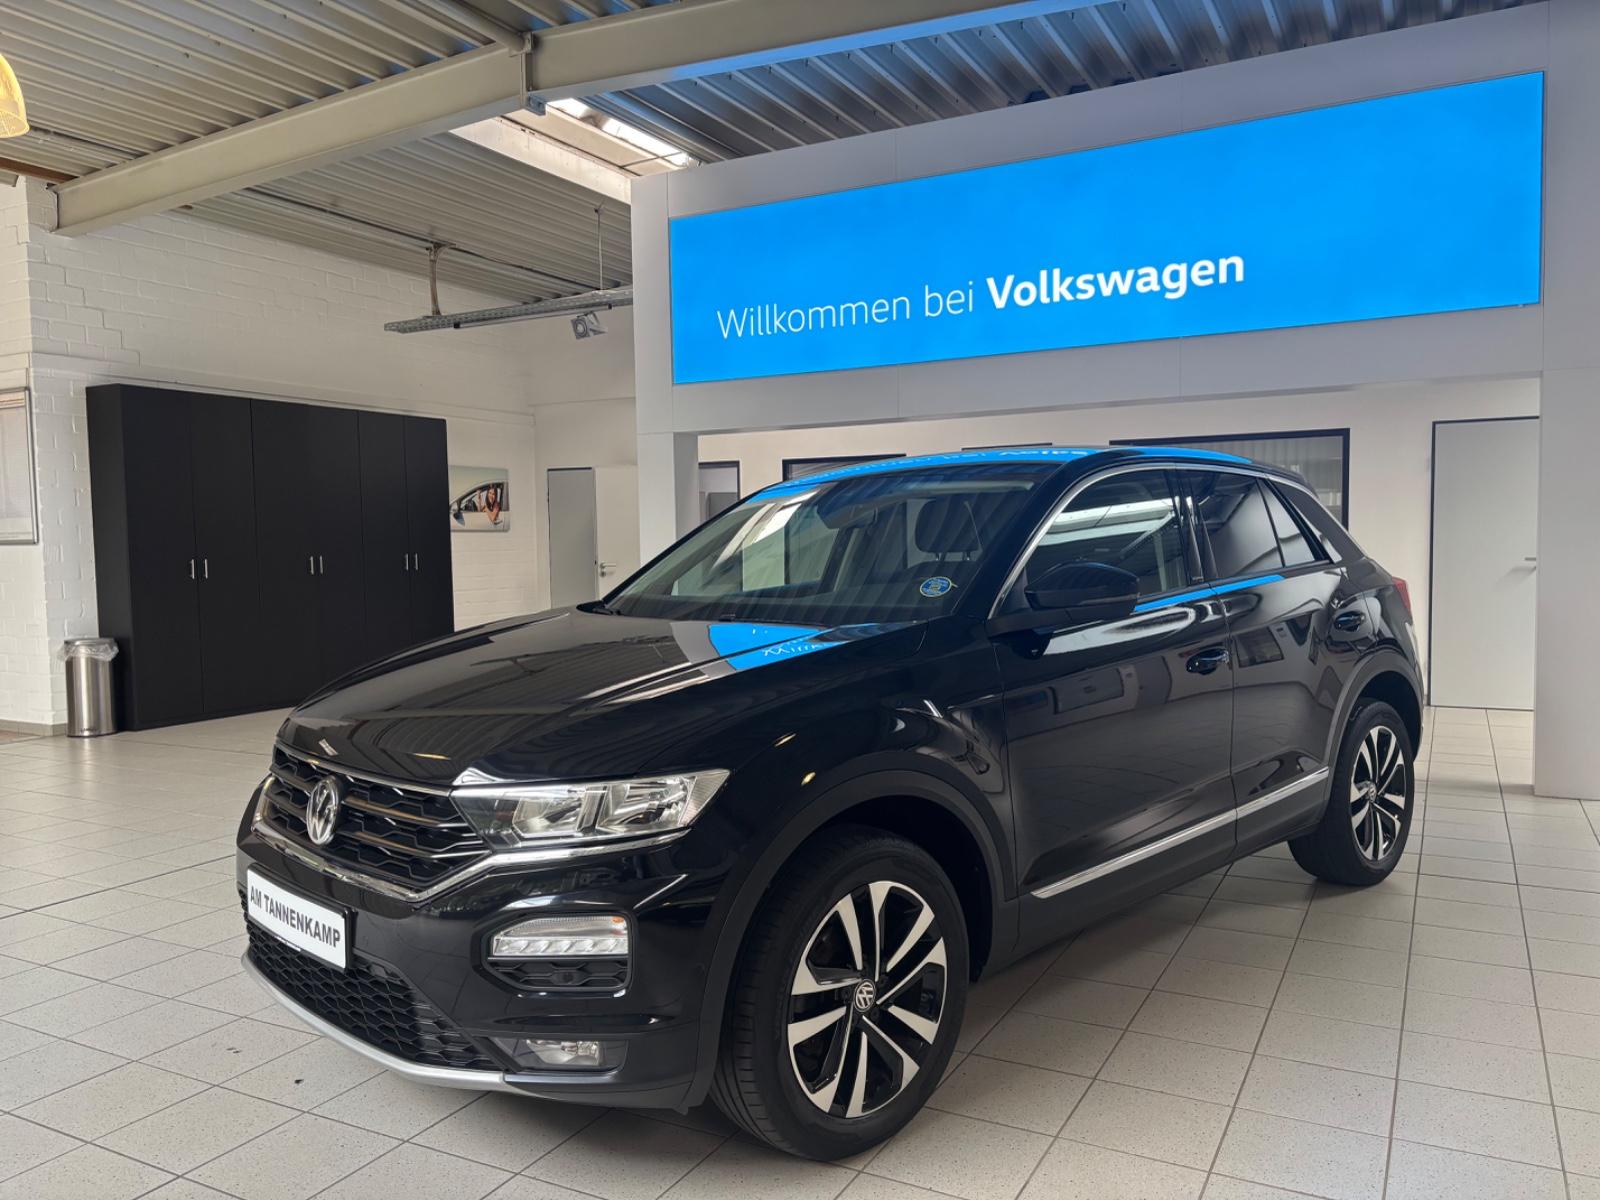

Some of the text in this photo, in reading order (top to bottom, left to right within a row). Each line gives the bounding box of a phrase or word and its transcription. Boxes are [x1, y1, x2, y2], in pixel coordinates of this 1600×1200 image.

[717, 255, 1245, 339] Willkommen bei Volkswagen
[250, 887, 341, 948] AM TANNENKAMP
